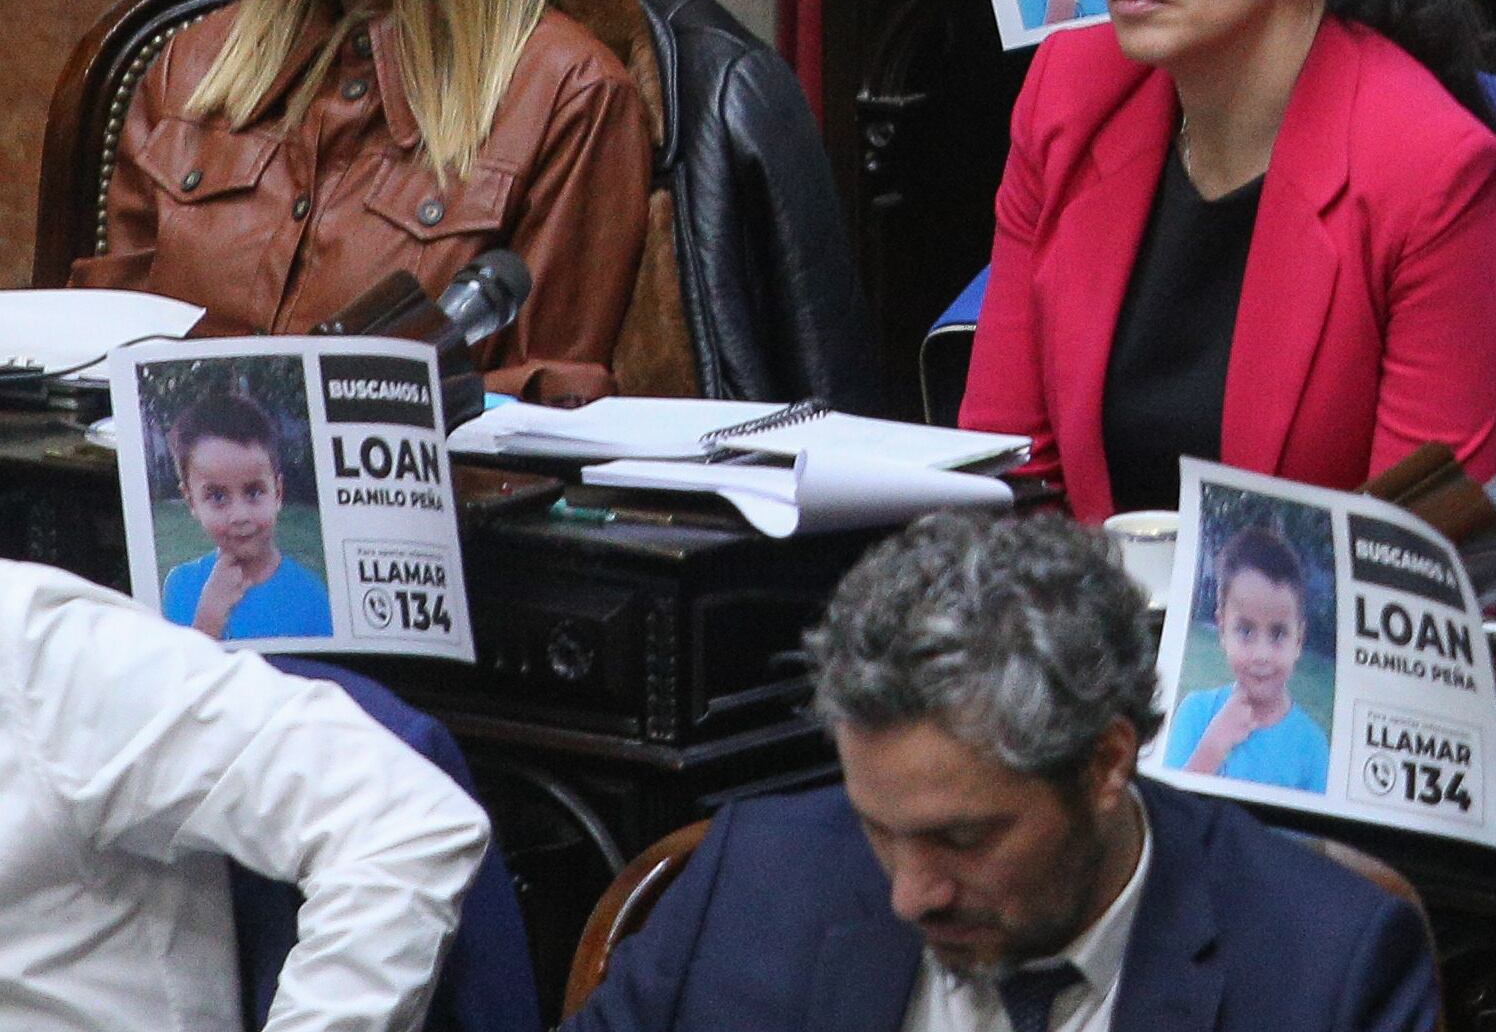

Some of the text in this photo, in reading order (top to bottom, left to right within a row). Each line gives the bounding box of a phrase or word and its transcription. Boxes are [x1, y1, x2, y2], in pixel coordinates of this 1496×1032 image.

[328, 379, 430, 406] BUSCAMOS A
[332, 436, 440, 485] LOAN
[337, 486, 443, 511] DANILO PEÑA
[359, 560, 446, 589] LLAMAR
[1355, 538, 1445, 583] BUSCAMOS
[394, 591, 451, 634] 134
[1355, 594, 1474, 666] LOAN
[1355, 648, 1476, 693] DANILO PEÑA
[1367, 723, 1472, 767] LLAMAR
[1402, 760, 1472, 813] 134
